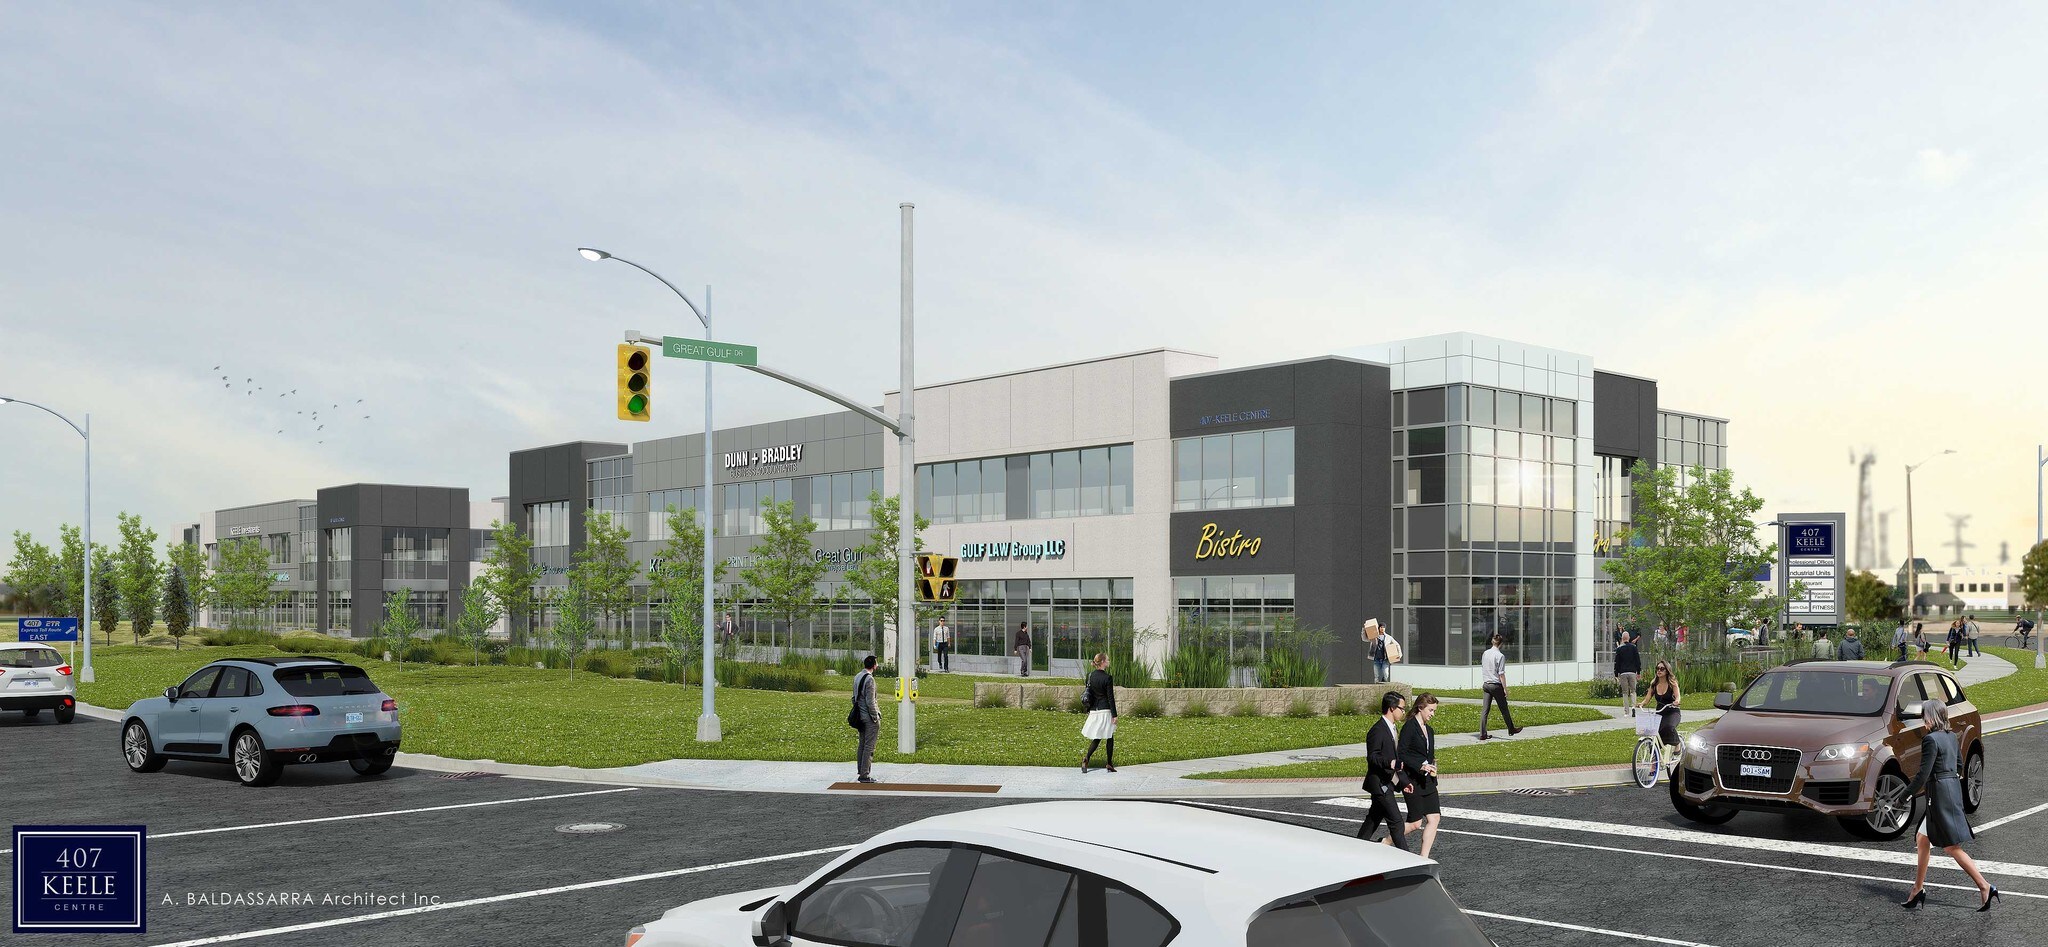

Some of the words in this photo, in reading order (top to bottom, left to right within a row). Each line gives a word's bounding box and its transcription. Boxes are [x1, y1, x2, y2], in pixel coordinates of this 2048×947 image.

[673, 343, 705, 355] GREAT
[707, 346, 732, 359] GULF
[1239, 408, 1271, 420] CENTRE
[725, 451, 749, 470] DUNN
[762, 444, 803, 465] BRADLEY
[1801, 528, 1820, 537] 407
[1195, 522, 1262, 560] Bistro
[1796, 538, 1825, 546] KEELE
[815, 547, 841, 563] Great
[961, 543, 987, 560] GULF
[988, 542, 1011, 559] LAW
[1012, 541, 1044, 561] Group
[1044, 540, 1065, 557] LLC
